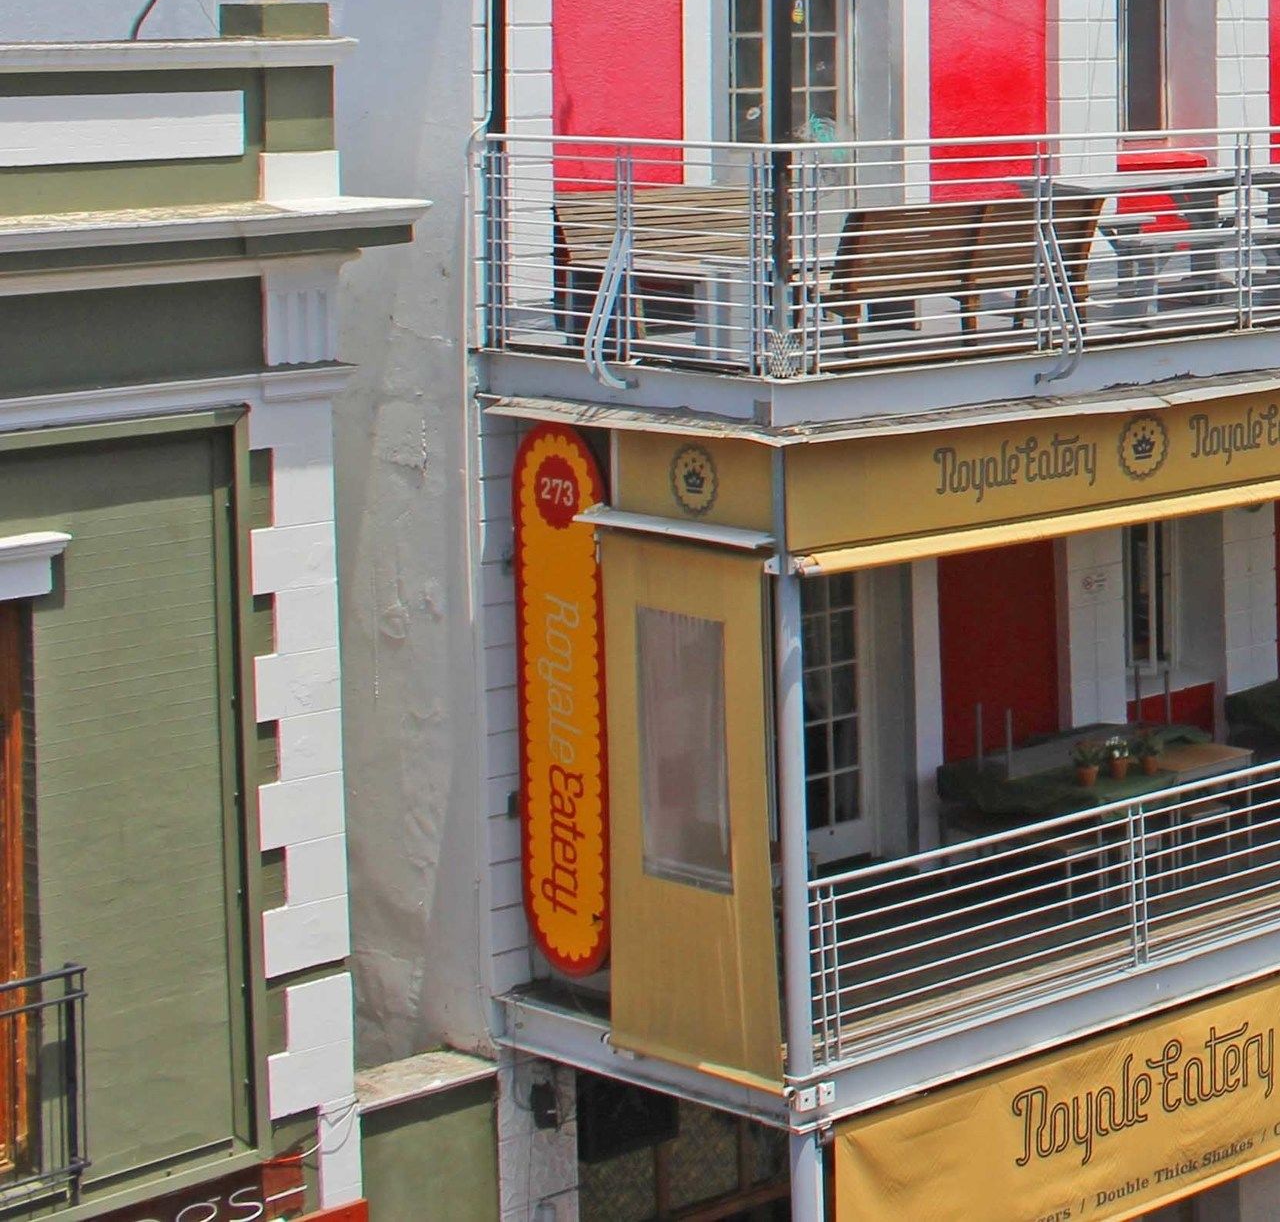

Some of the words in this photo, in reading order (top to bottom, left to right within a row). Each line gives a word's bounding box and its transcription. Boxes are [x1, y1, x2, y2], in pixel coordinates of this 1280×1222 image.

[933, 436, 1018, 503] Royale
[1015, 434, 1097, 486] Eatery
[1189, 406, 1262, 466] Royale
[541, 476, 575, 508] 273
[539, 593, 580, 766] Royale
[542, 762, 584, 915] Eatery
[1012, 1053, 1152, 1168] Royale
[1146, 1021, 1275, 1114] Eatery
[1096, 1176, 1149, 1208] Double
[1153, 1160, 1200, 1183] Thick
[1202, 1137, 1254, 1165] Shakes
